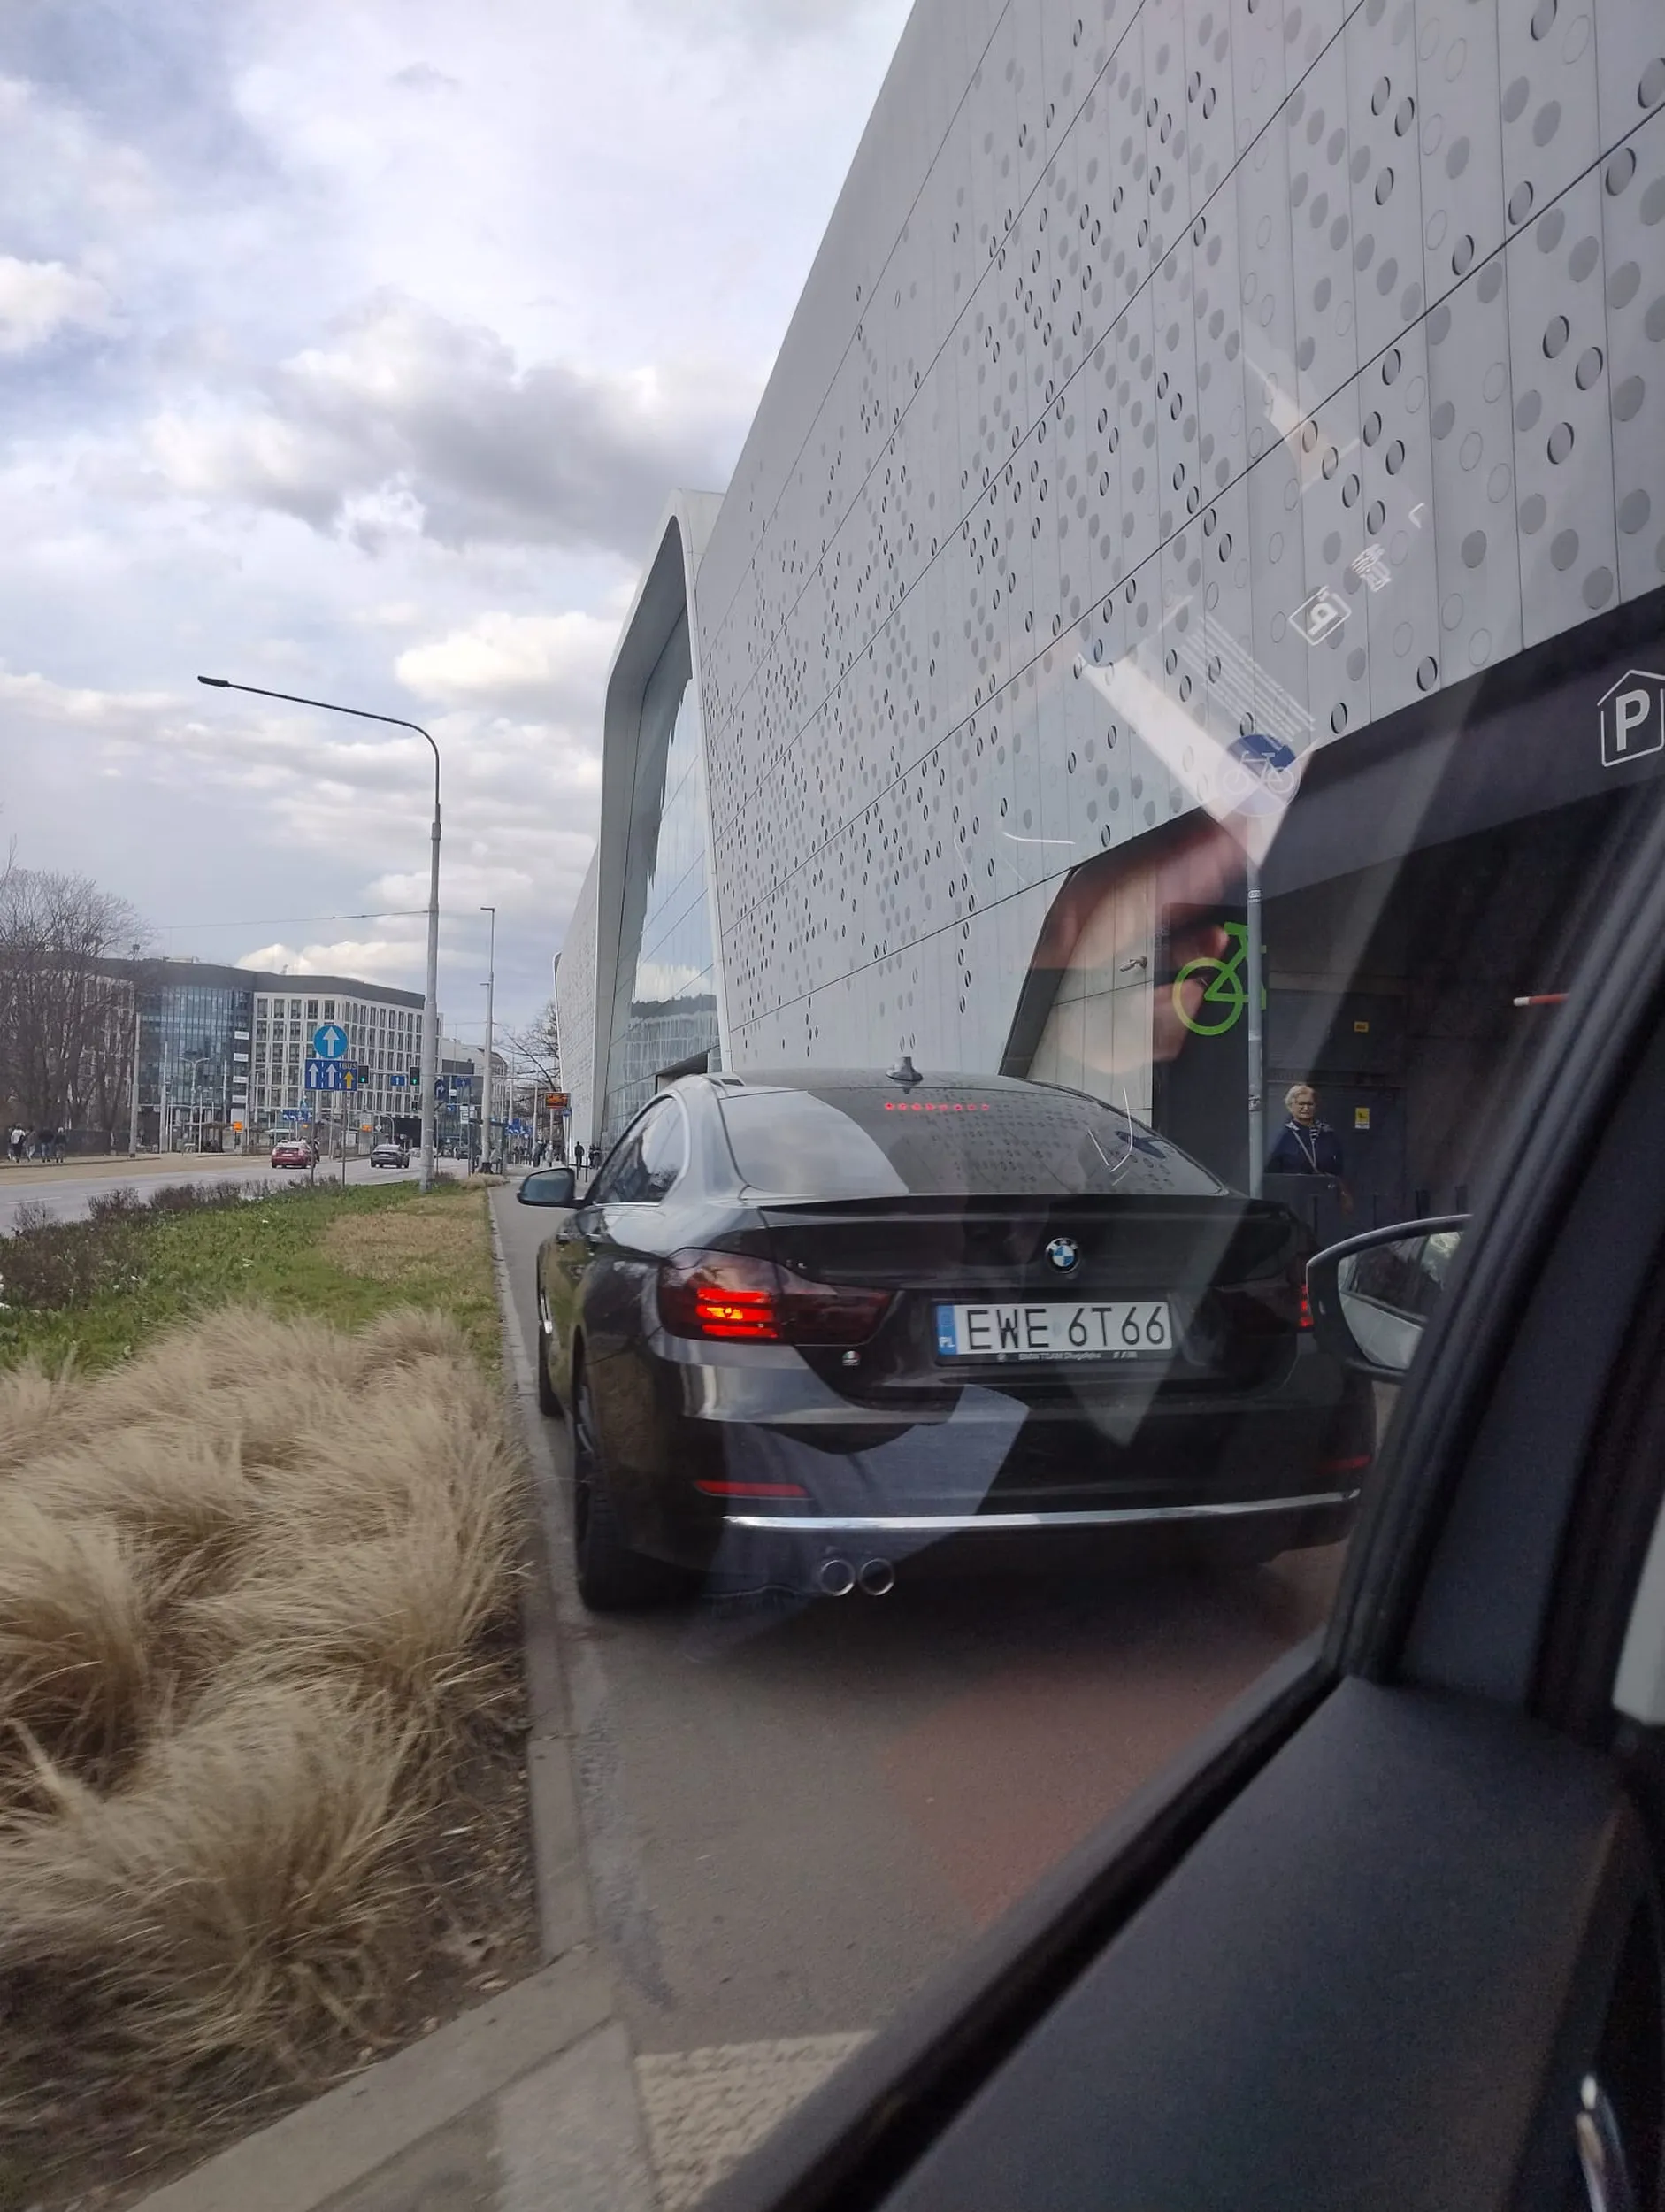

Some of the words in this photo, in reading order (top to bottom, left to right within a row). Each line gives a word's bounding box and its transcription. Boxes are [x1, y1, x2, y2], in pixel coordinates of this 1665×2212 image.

[1615, 689, 1651, 752] P
[939, 1336, 955, 1348] PL
[967, 1308, 1050, 1350] EWE
[1068, 1306, 1165, 1347] 6T66
